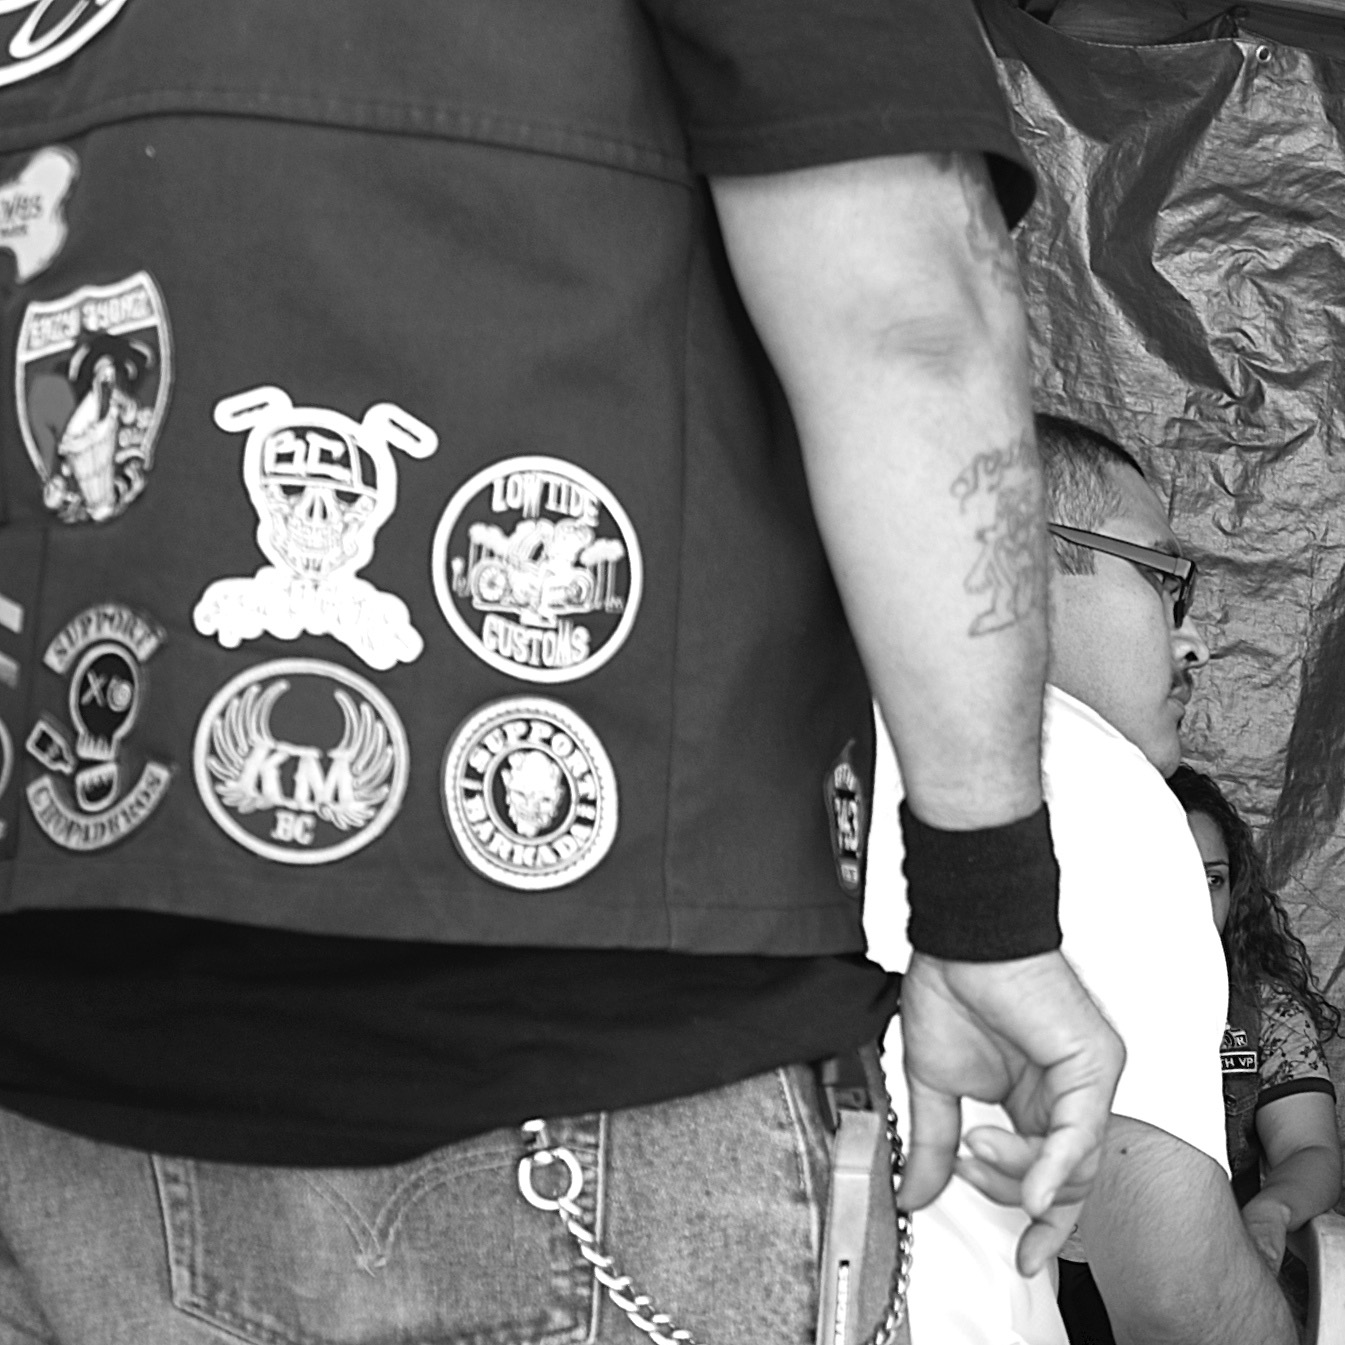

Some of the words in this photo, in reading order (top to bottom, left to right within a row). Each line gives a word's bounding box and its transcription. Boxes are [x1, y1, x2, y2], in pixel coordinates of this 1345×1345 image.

[491, 472, 545, 518] LOW
[543, 479, 600, 528] TIDE
[482, 614, 591, 668] CUSTOMS
[240, 742, 356, 812] KM
[468, 720, 598, 800] SUPPORT
[270, 808, 316, 844] BC
[463, 794, 594, 867] BARKADA
[1238, 1057, 1254, 1068] VP
